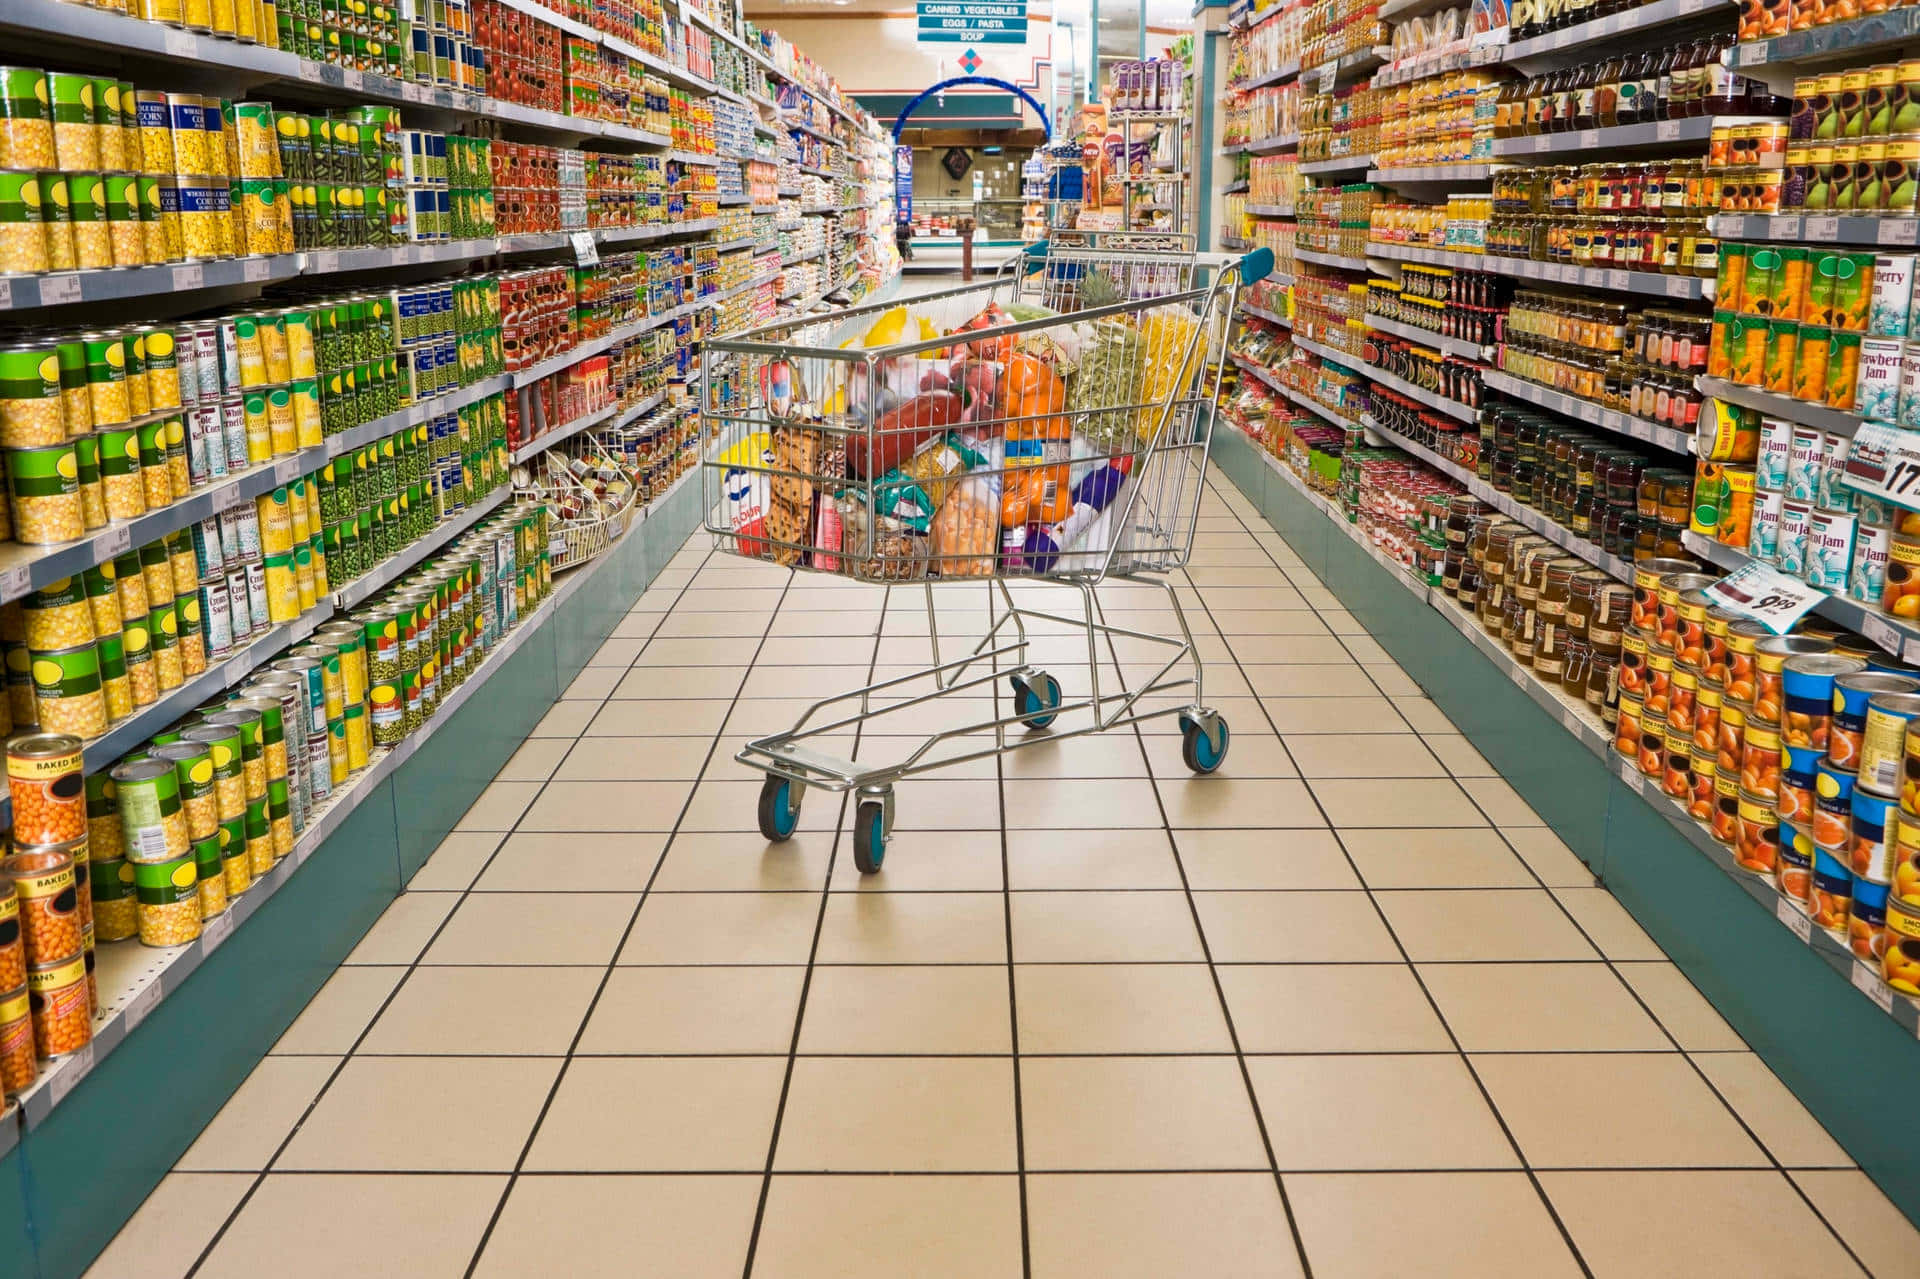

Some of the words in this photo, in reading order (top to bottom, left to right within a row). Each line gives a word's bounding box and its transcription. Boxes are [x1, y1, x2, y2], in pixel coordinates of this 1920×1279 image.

[925, 4, 961, 15] CANNED
[963, 5, 1019, 16] VEGETABLES
[942, 18, 967, 28] EGGS
[978, 19, 1004, 29] PASTA
[960, 32, 985, 41] SOUP
[1865, 365, 1887, 380] Jam
[1768, 440, 1787, 452] Jam
[732, 505, 761, 526] FLOUR
[1760, 509, 1779, 522] Jam
[1798, 523, 1810, 535] Ja
[1823, 534, 1845, 548] Jam
[1866, 548, 1889, 562] Jam
[1896, 546, 1920, 555] ORANG
[36, 759, 69, 770] BAKED
[37, 872, 67, 887] BAKED
[1904, 917, 1920, 928] SMO
